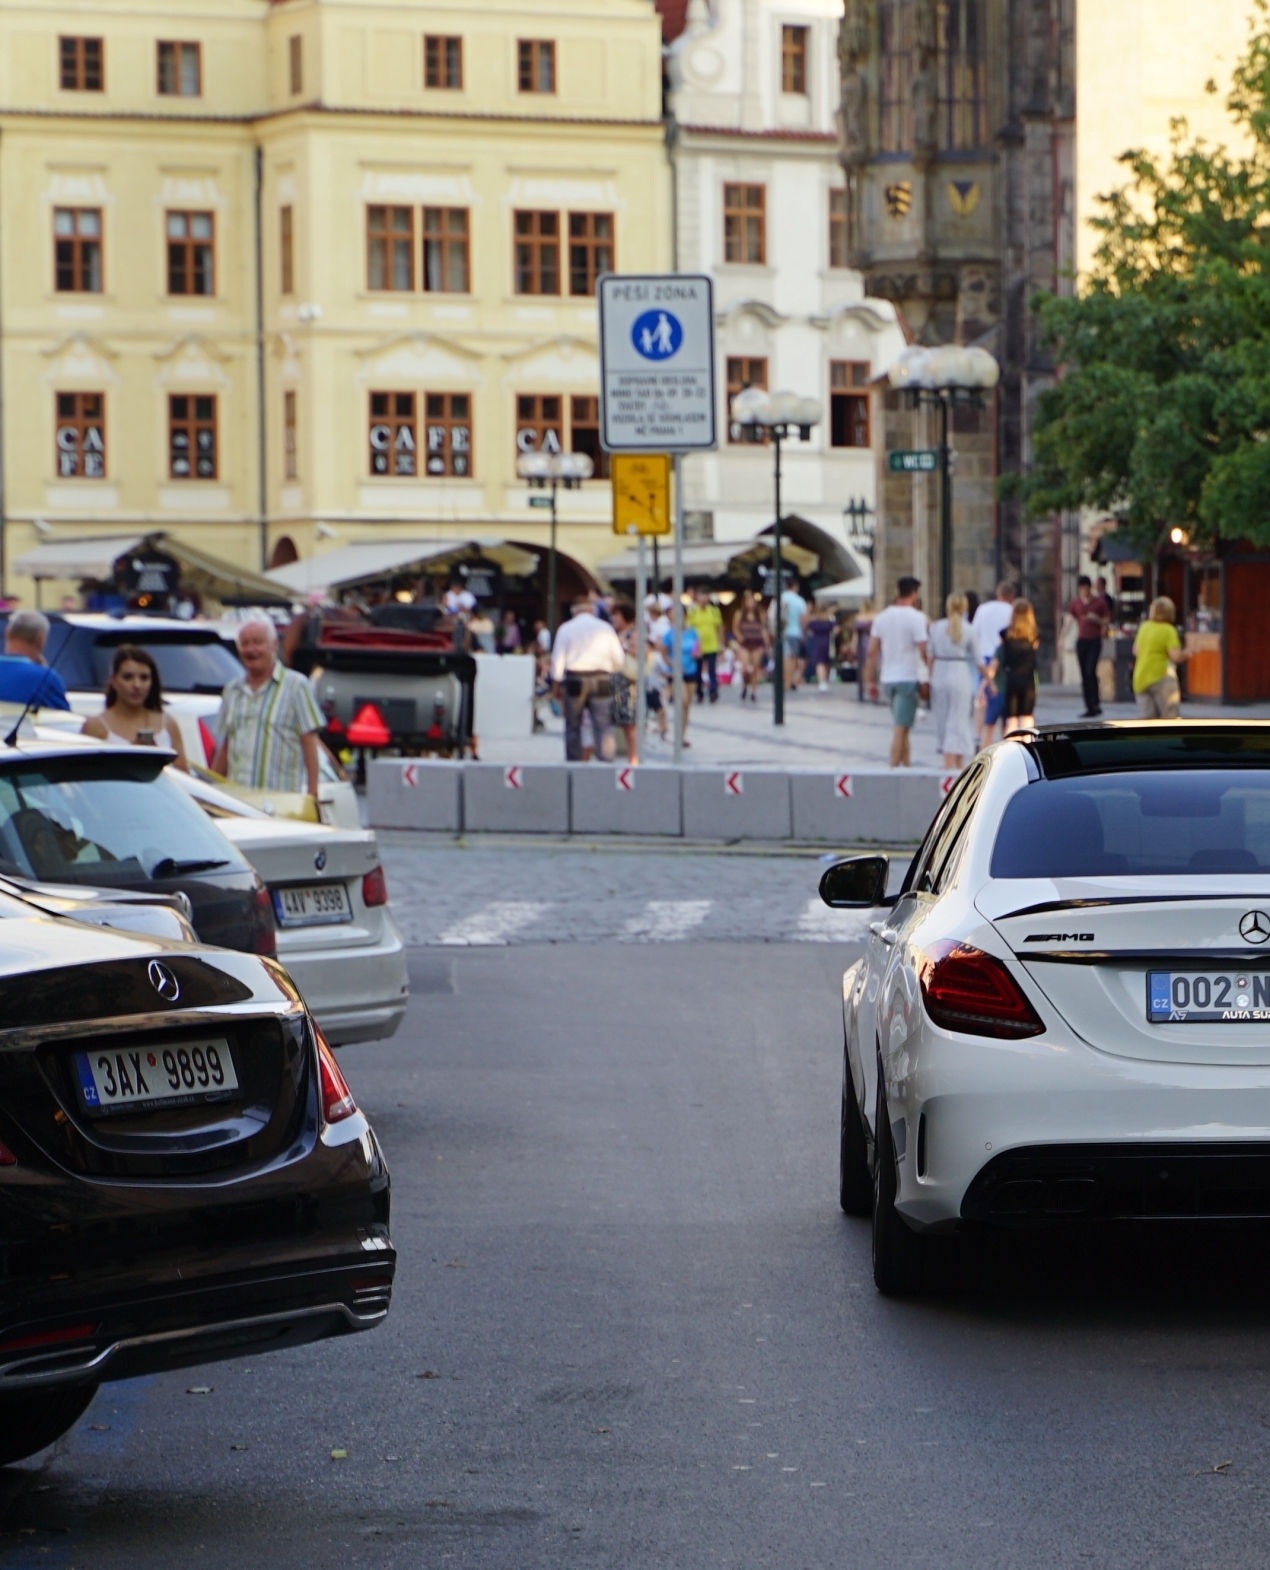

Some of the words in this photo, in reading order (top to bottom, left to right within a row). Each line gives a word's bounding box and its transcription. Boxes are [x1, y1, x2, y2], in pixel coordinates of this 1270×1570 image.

[654, 284, 698, 300] ZÓNA
[57, 427, 104, 450] CA
[517, 428, 561, 451] CA
[312, 888, 343, 913] 9398
[1044, 933, 1095, 942] AMG
[1153, 1000, 1169, 1009] CZ
[1172, 976, 1232, 1008] 002
[1222, 1010, 1250, 1020] AUTA
[83, 1086, 97, 1100] CZ
[97, 1052, 150, 1098] 3AX
[162, 1045, 225, 1090] 9899
